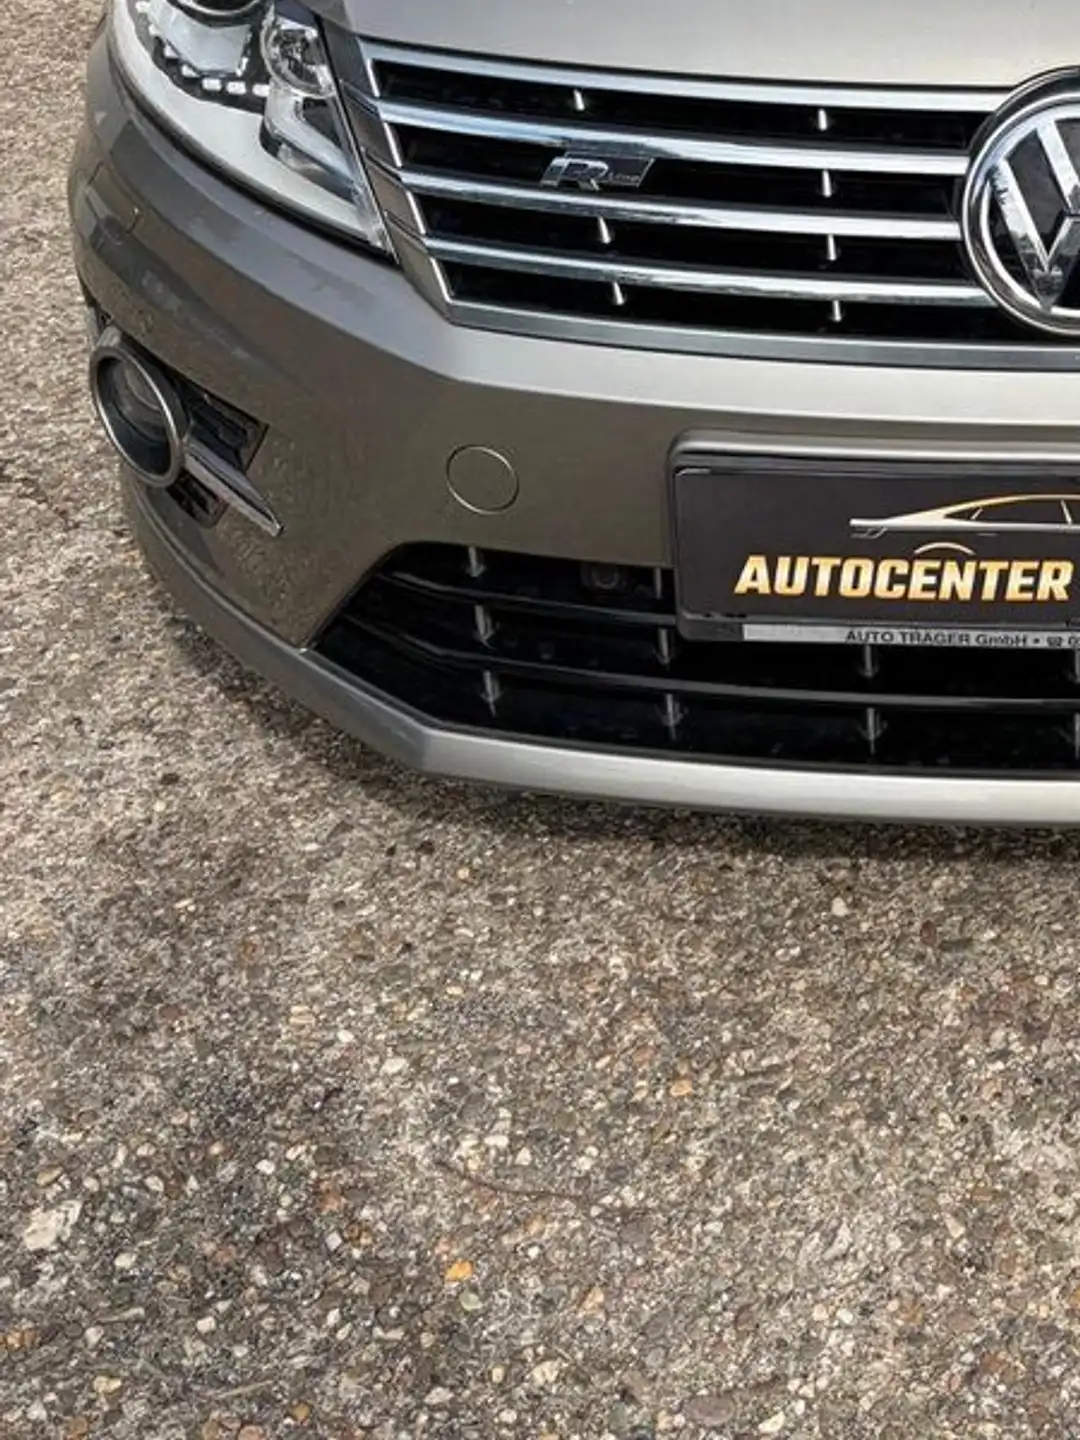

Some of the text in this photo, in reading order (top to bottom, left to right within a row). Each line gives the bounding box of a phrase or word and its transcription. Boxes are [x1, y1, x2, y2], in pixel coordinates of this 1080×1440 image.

[734, 555, 1075, 601] AUTOCENTER
[845, 629, 895, 644] AUTO
[975, 633, 1028, 647] GmbH
